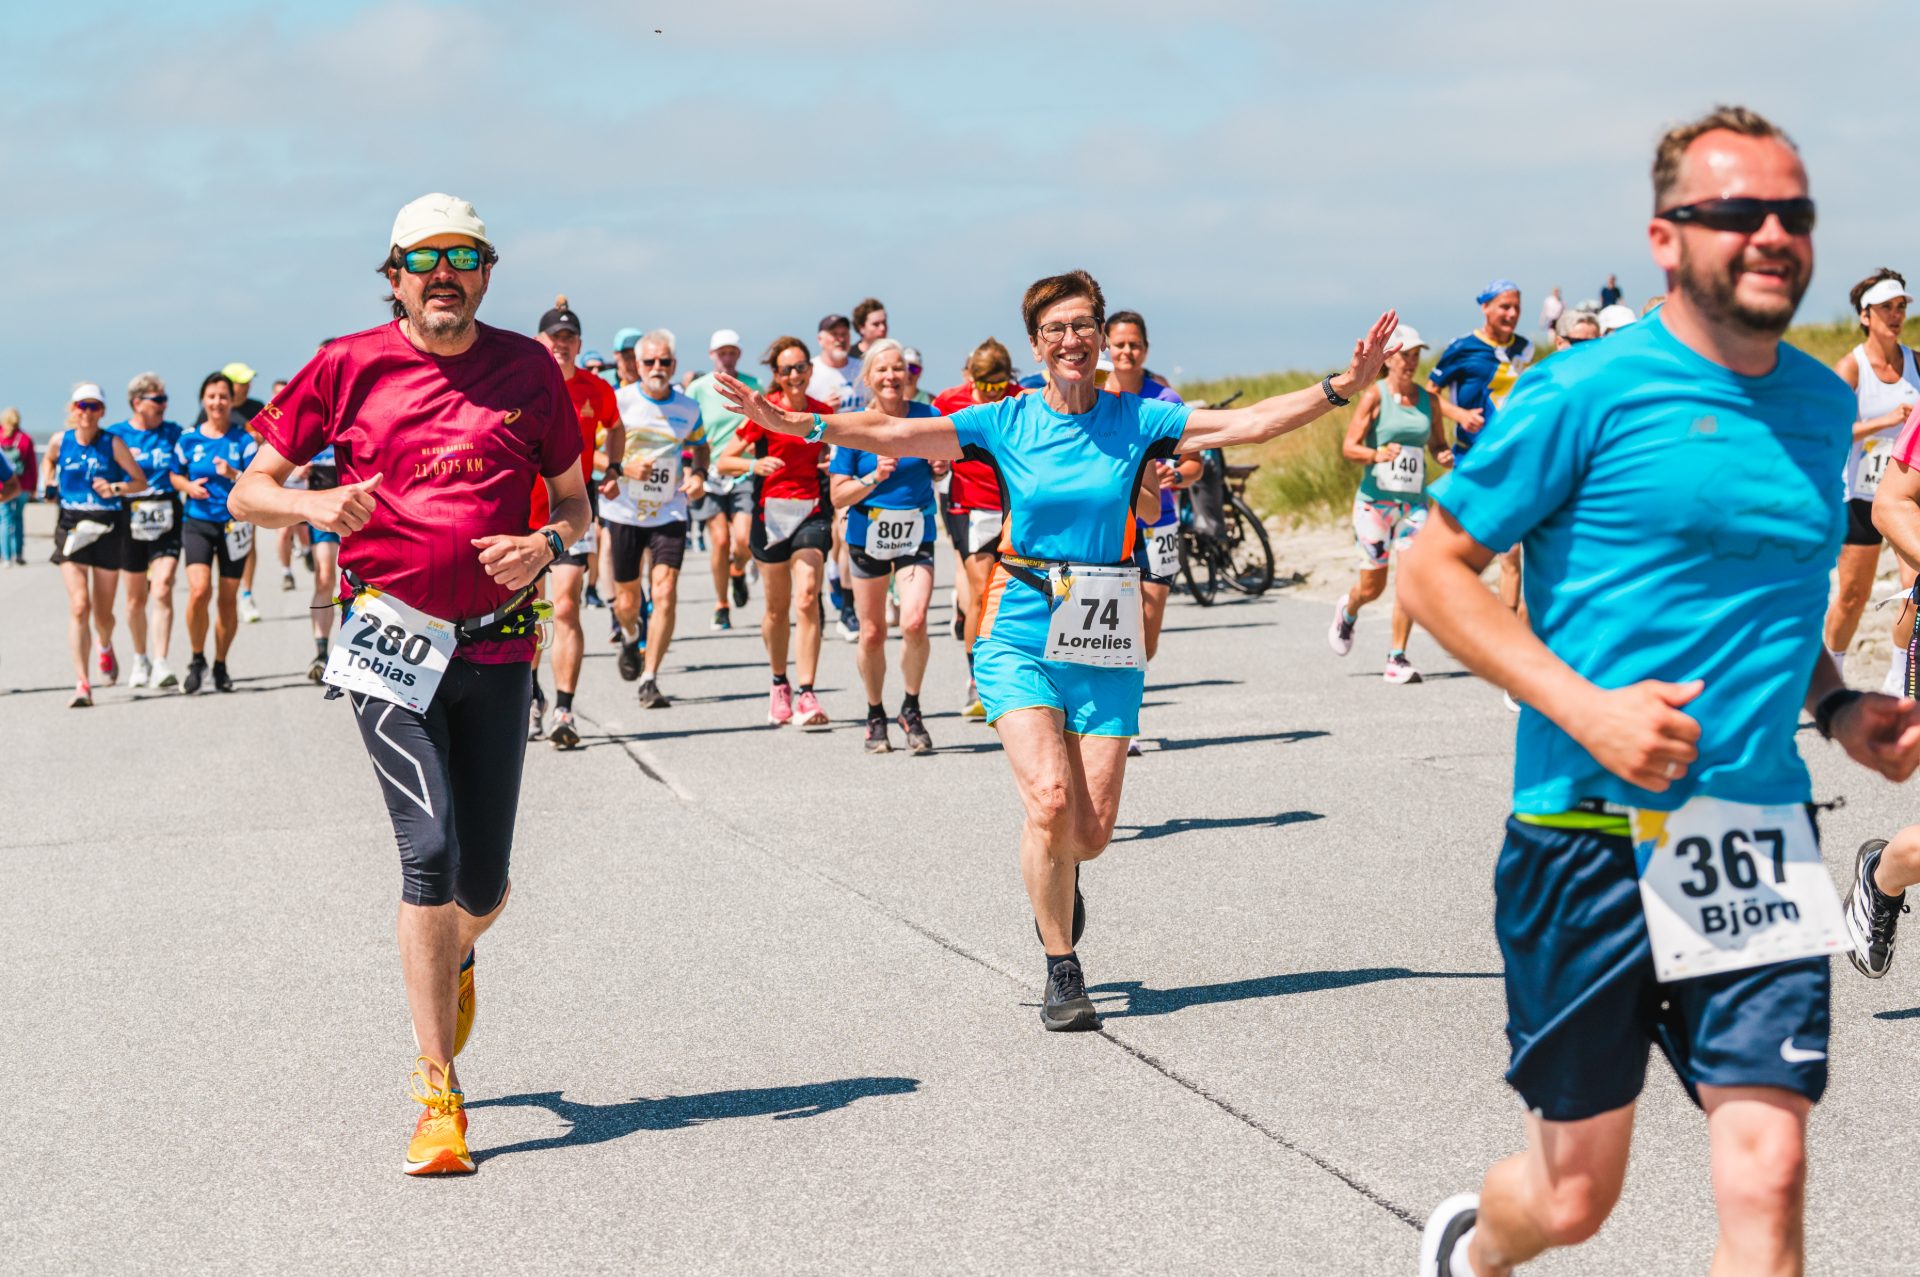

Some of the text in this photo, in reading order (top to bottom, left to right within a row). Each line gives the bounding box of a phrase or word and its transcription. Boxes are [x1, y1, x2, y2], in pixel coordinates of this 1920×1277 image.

[414, 458, 483, 479] 21,0975 KM
[650, 468, 670, 484] 56
[643, 484, 662, 492] Dirk
[877, 521, 914, 540] 807
[876, 540, 912, 550] Sabine
[1080, 598, 1119, 631] 74
[351, 612, 432, 666] 280
[1058, 632, 1132, 650] Lorelies
[347, 649, 417, 687] Tobias
[1674, 828, 1786, 897] 367
[1700, 898, 1800, 936] Björn
